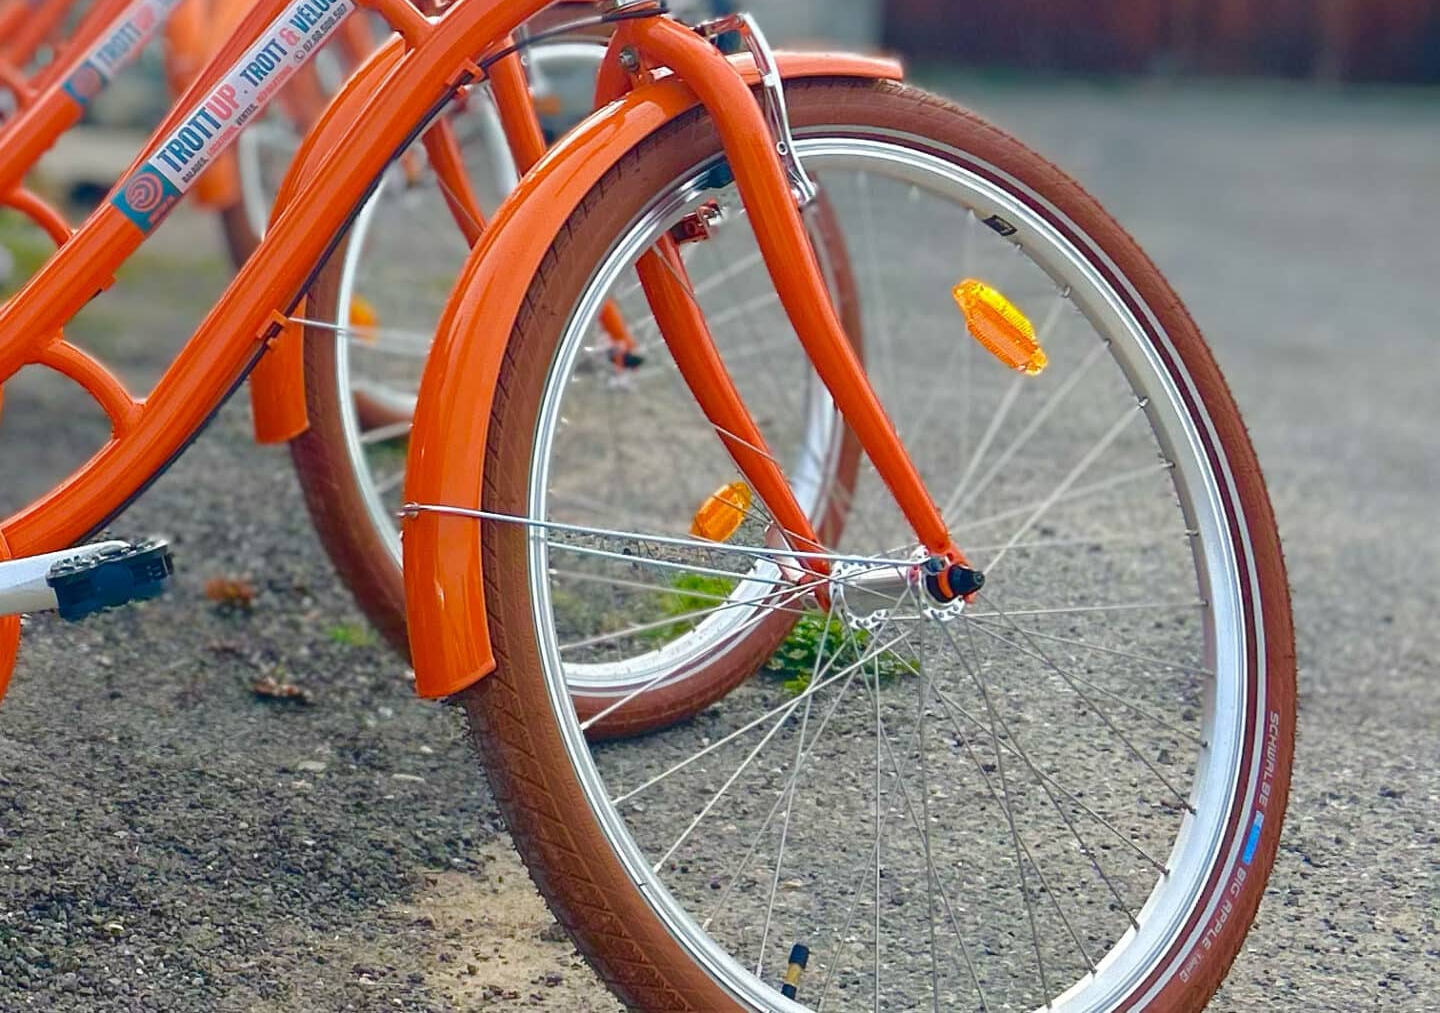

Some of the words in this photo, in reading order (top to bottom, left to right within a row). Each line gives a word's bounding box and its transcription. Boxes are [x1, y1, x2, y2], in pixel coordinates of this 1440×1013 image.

[239, 37, 289, 88] TROTT
[278, 27, 301, 47] &
[1259, 711, 1280, 807] SCHWALBE
[1229, 866, 1248, 899] BIG
[1201, 898, 1233, 951] APPLE
